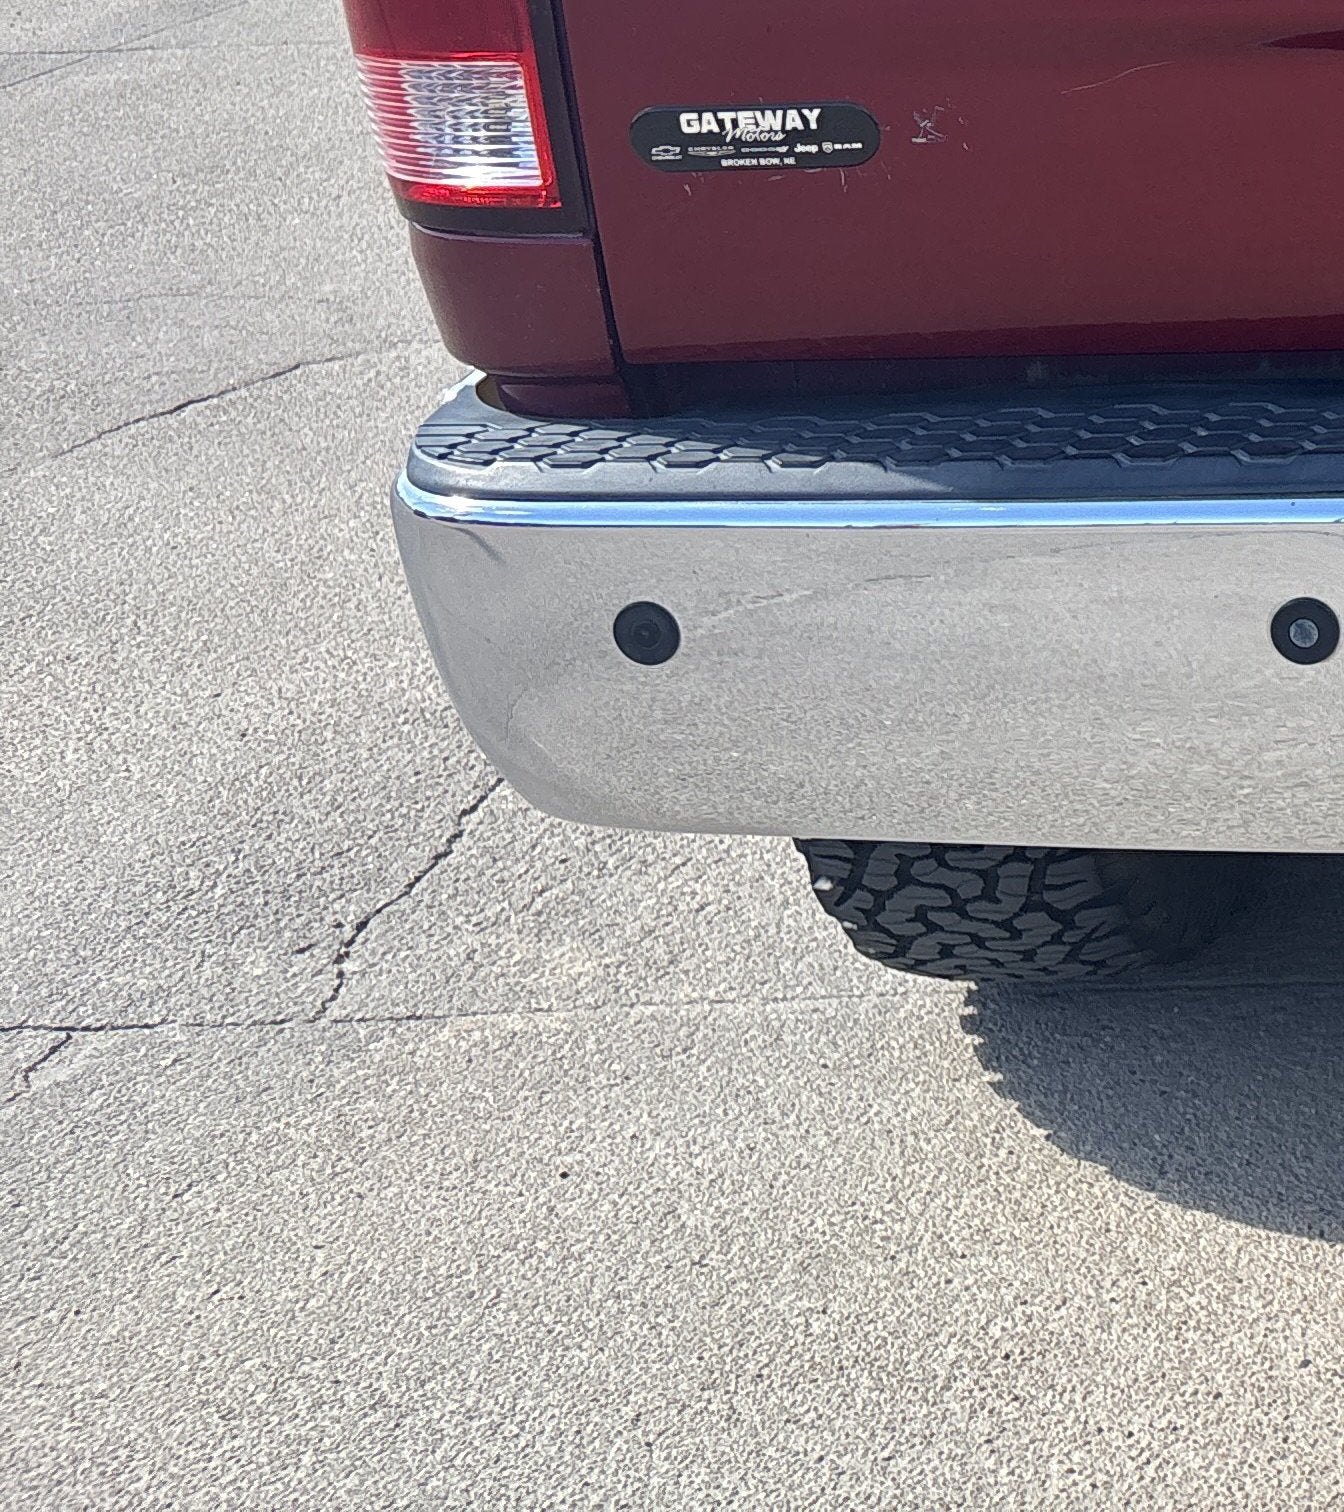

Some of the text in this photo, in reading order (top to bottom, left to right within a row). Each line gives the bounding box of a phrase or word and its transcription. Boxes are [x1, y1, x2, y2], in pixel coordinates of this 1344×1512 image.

[679, 108, 822, 134] GATEWAY
[722, 125, 787, 143] Motors
[794, 142, 819, 154] Jeep
[720, 158, 758, 167] BROKEN
